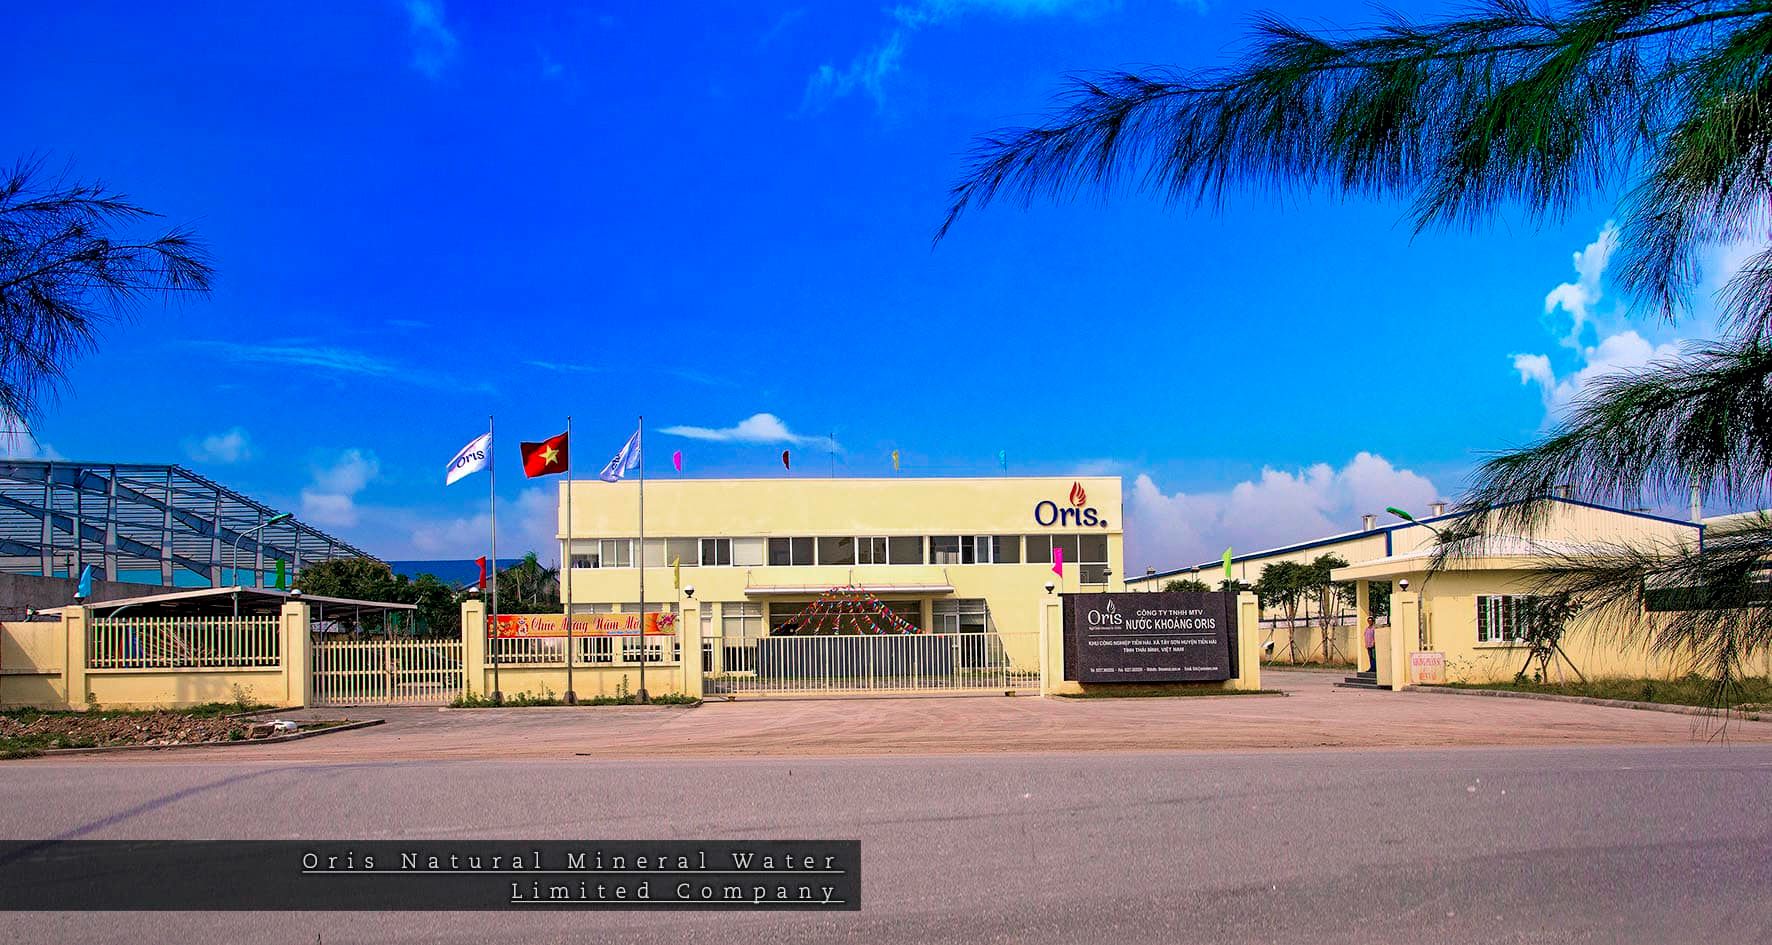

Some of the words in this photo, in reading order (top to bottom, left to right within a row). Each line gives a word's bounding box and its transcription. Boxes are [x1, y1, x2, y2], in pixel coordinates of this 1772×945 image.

[456, 450, 485, 468] Oris
[1088, 610, 1122, 625] Oris
[1136, 609, 1157, 617] CÔNG
[1125, 616, 1153, 630] NƯỚC
[1194, 618, 1216, 629] ORIS
